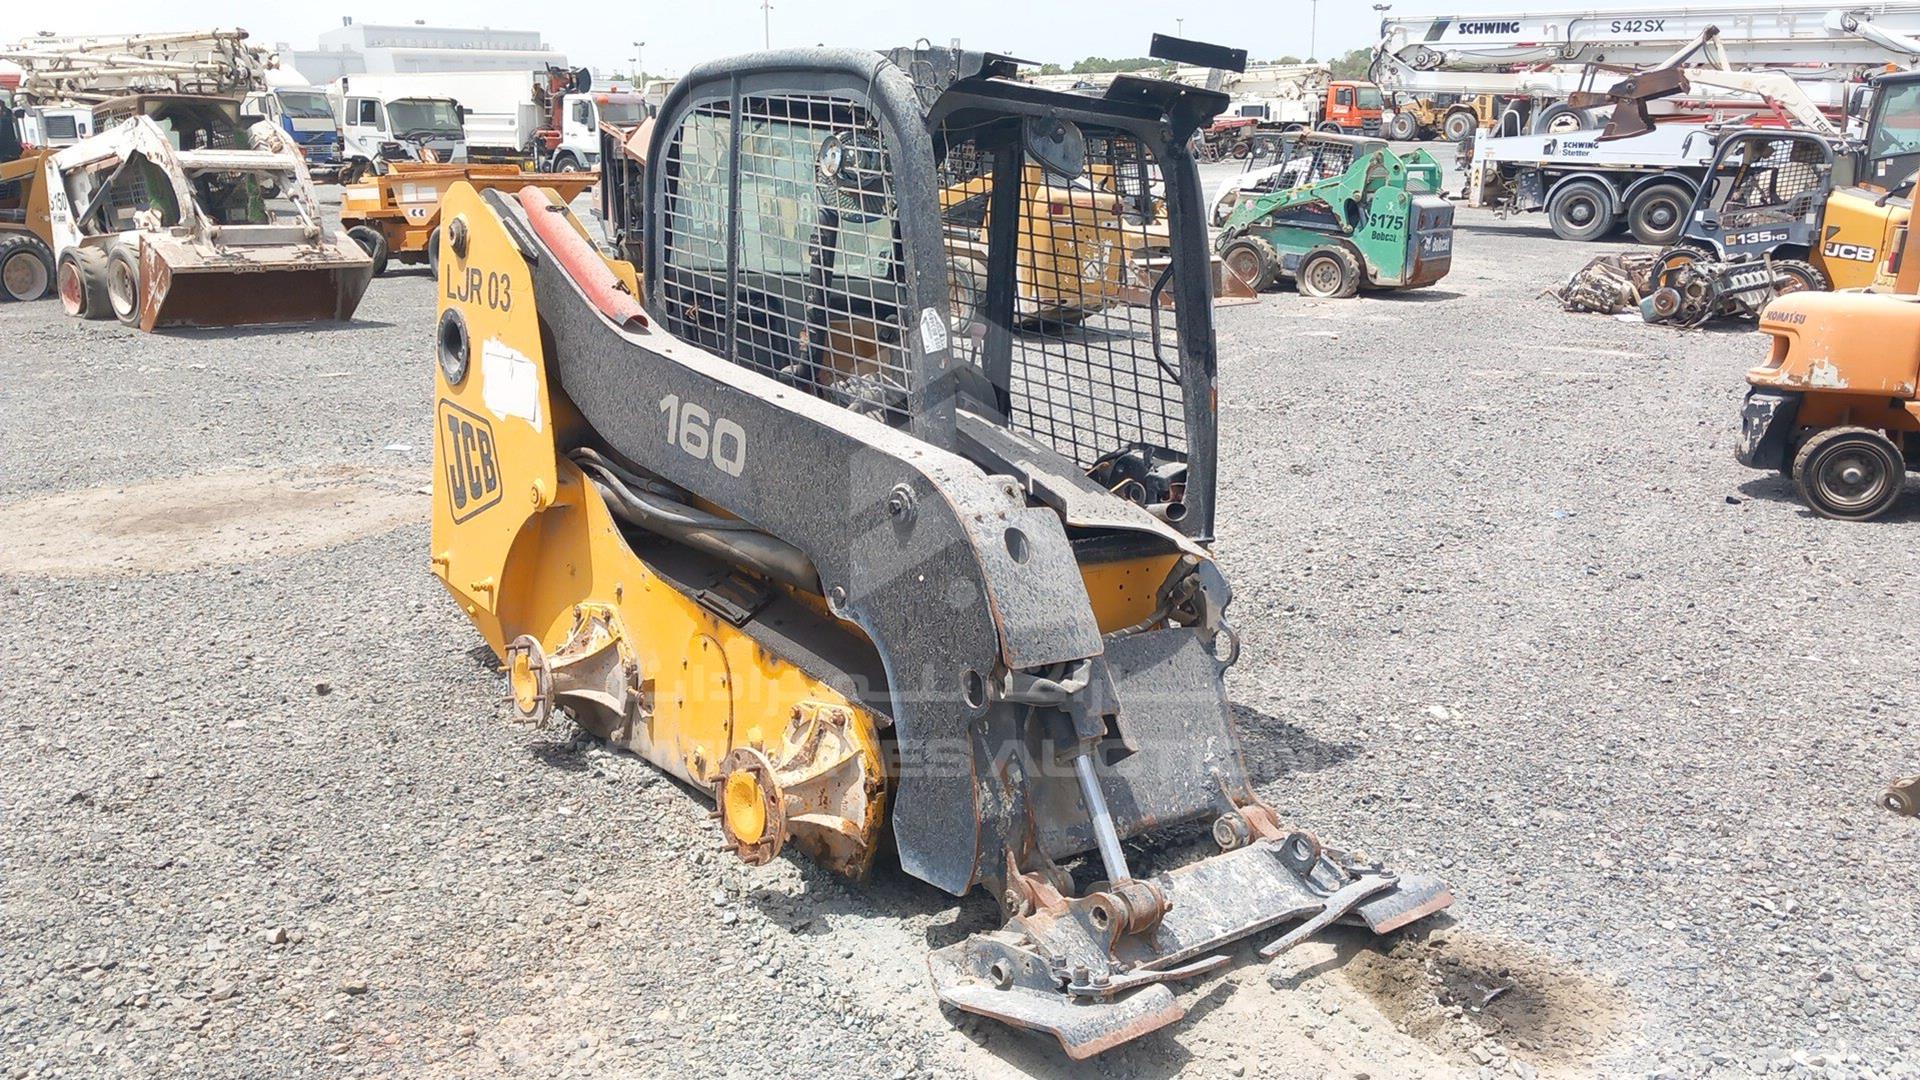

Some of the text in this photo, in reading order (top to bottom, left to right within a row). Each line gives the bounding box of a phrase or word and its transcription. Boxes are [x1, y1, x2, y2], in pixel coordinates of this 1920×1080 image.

[1458, 21, 1520, 34] SCHWING
[1562, 141, 1599, 149] SCHWING
[1370, 213, 1404, 230] S175
[1824, 243, 1875, 261] JCB
[446, 263, 512, 312] LJR 03
[659, 393, 747, 478] 160
[447, 413, 497, 510] JCB
